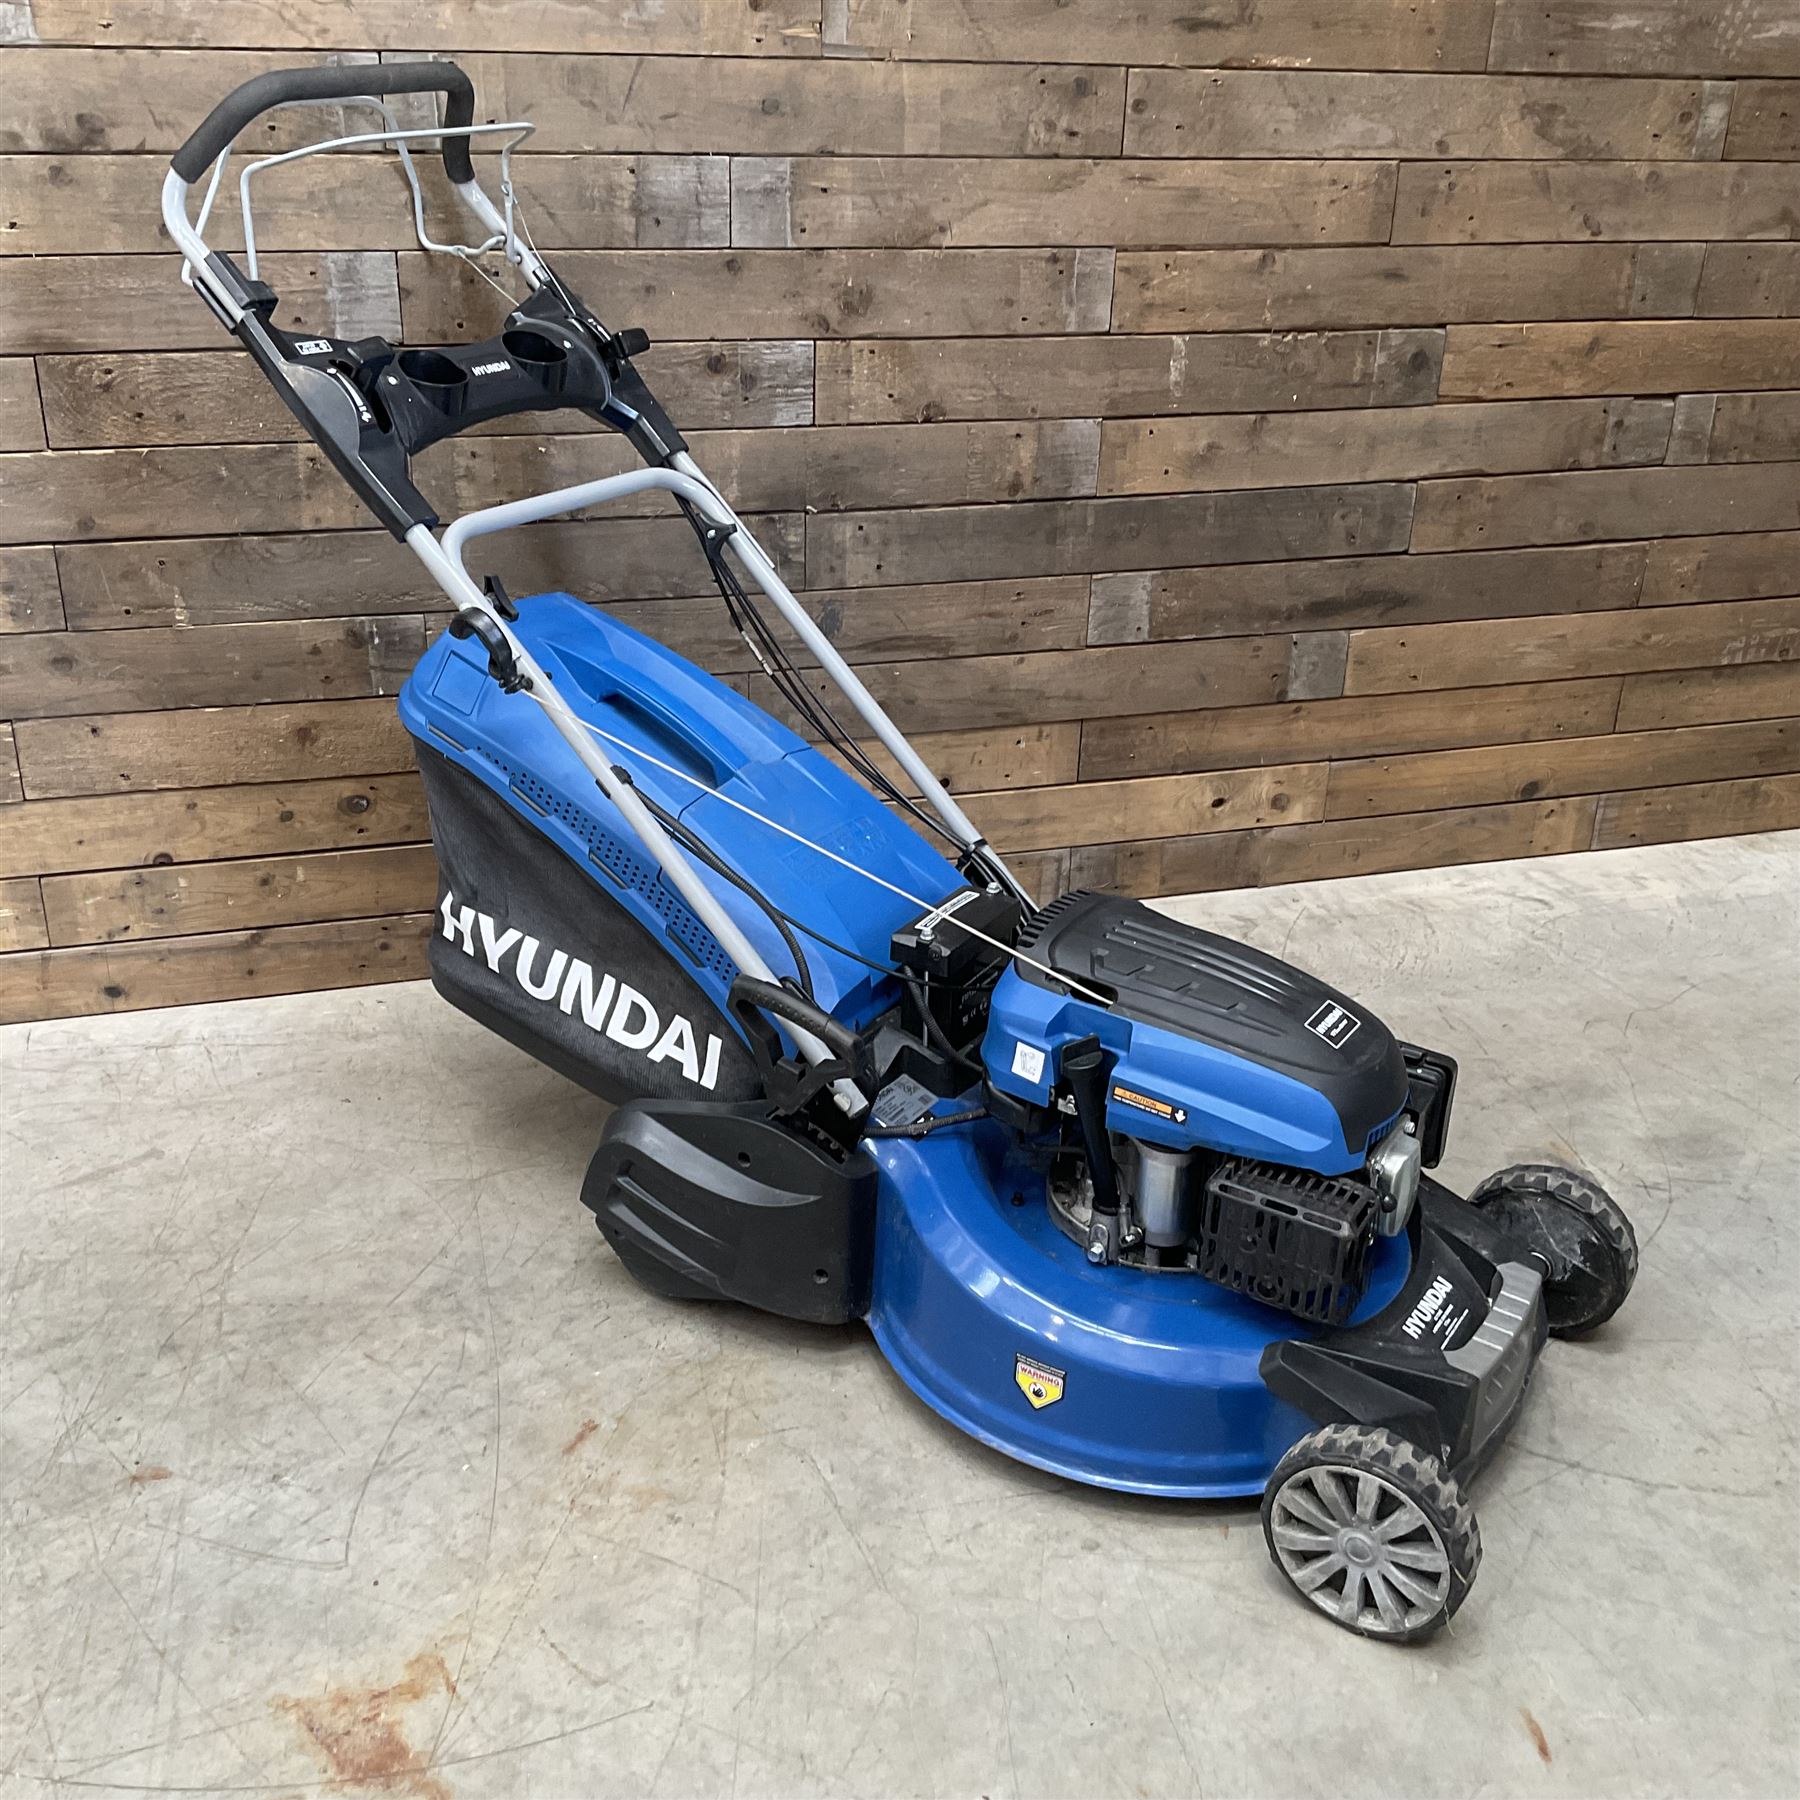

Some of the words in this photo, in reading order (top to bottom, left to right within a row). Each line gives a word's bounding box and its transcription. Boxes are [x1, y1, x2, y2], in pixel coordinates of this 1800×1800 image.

[471, 360, 511, 376] HYUNDAI
[440, 889, 723, 1091] HYUNDAI
[1315, 1007, 1344, 1035] HYUNDAI
[1128, 1094, 1157, 1108] CAUTION
[1401, 1275, 1453, 1340] HYUNDAI
[1020, 1364, 1060, 1386] WARNING
